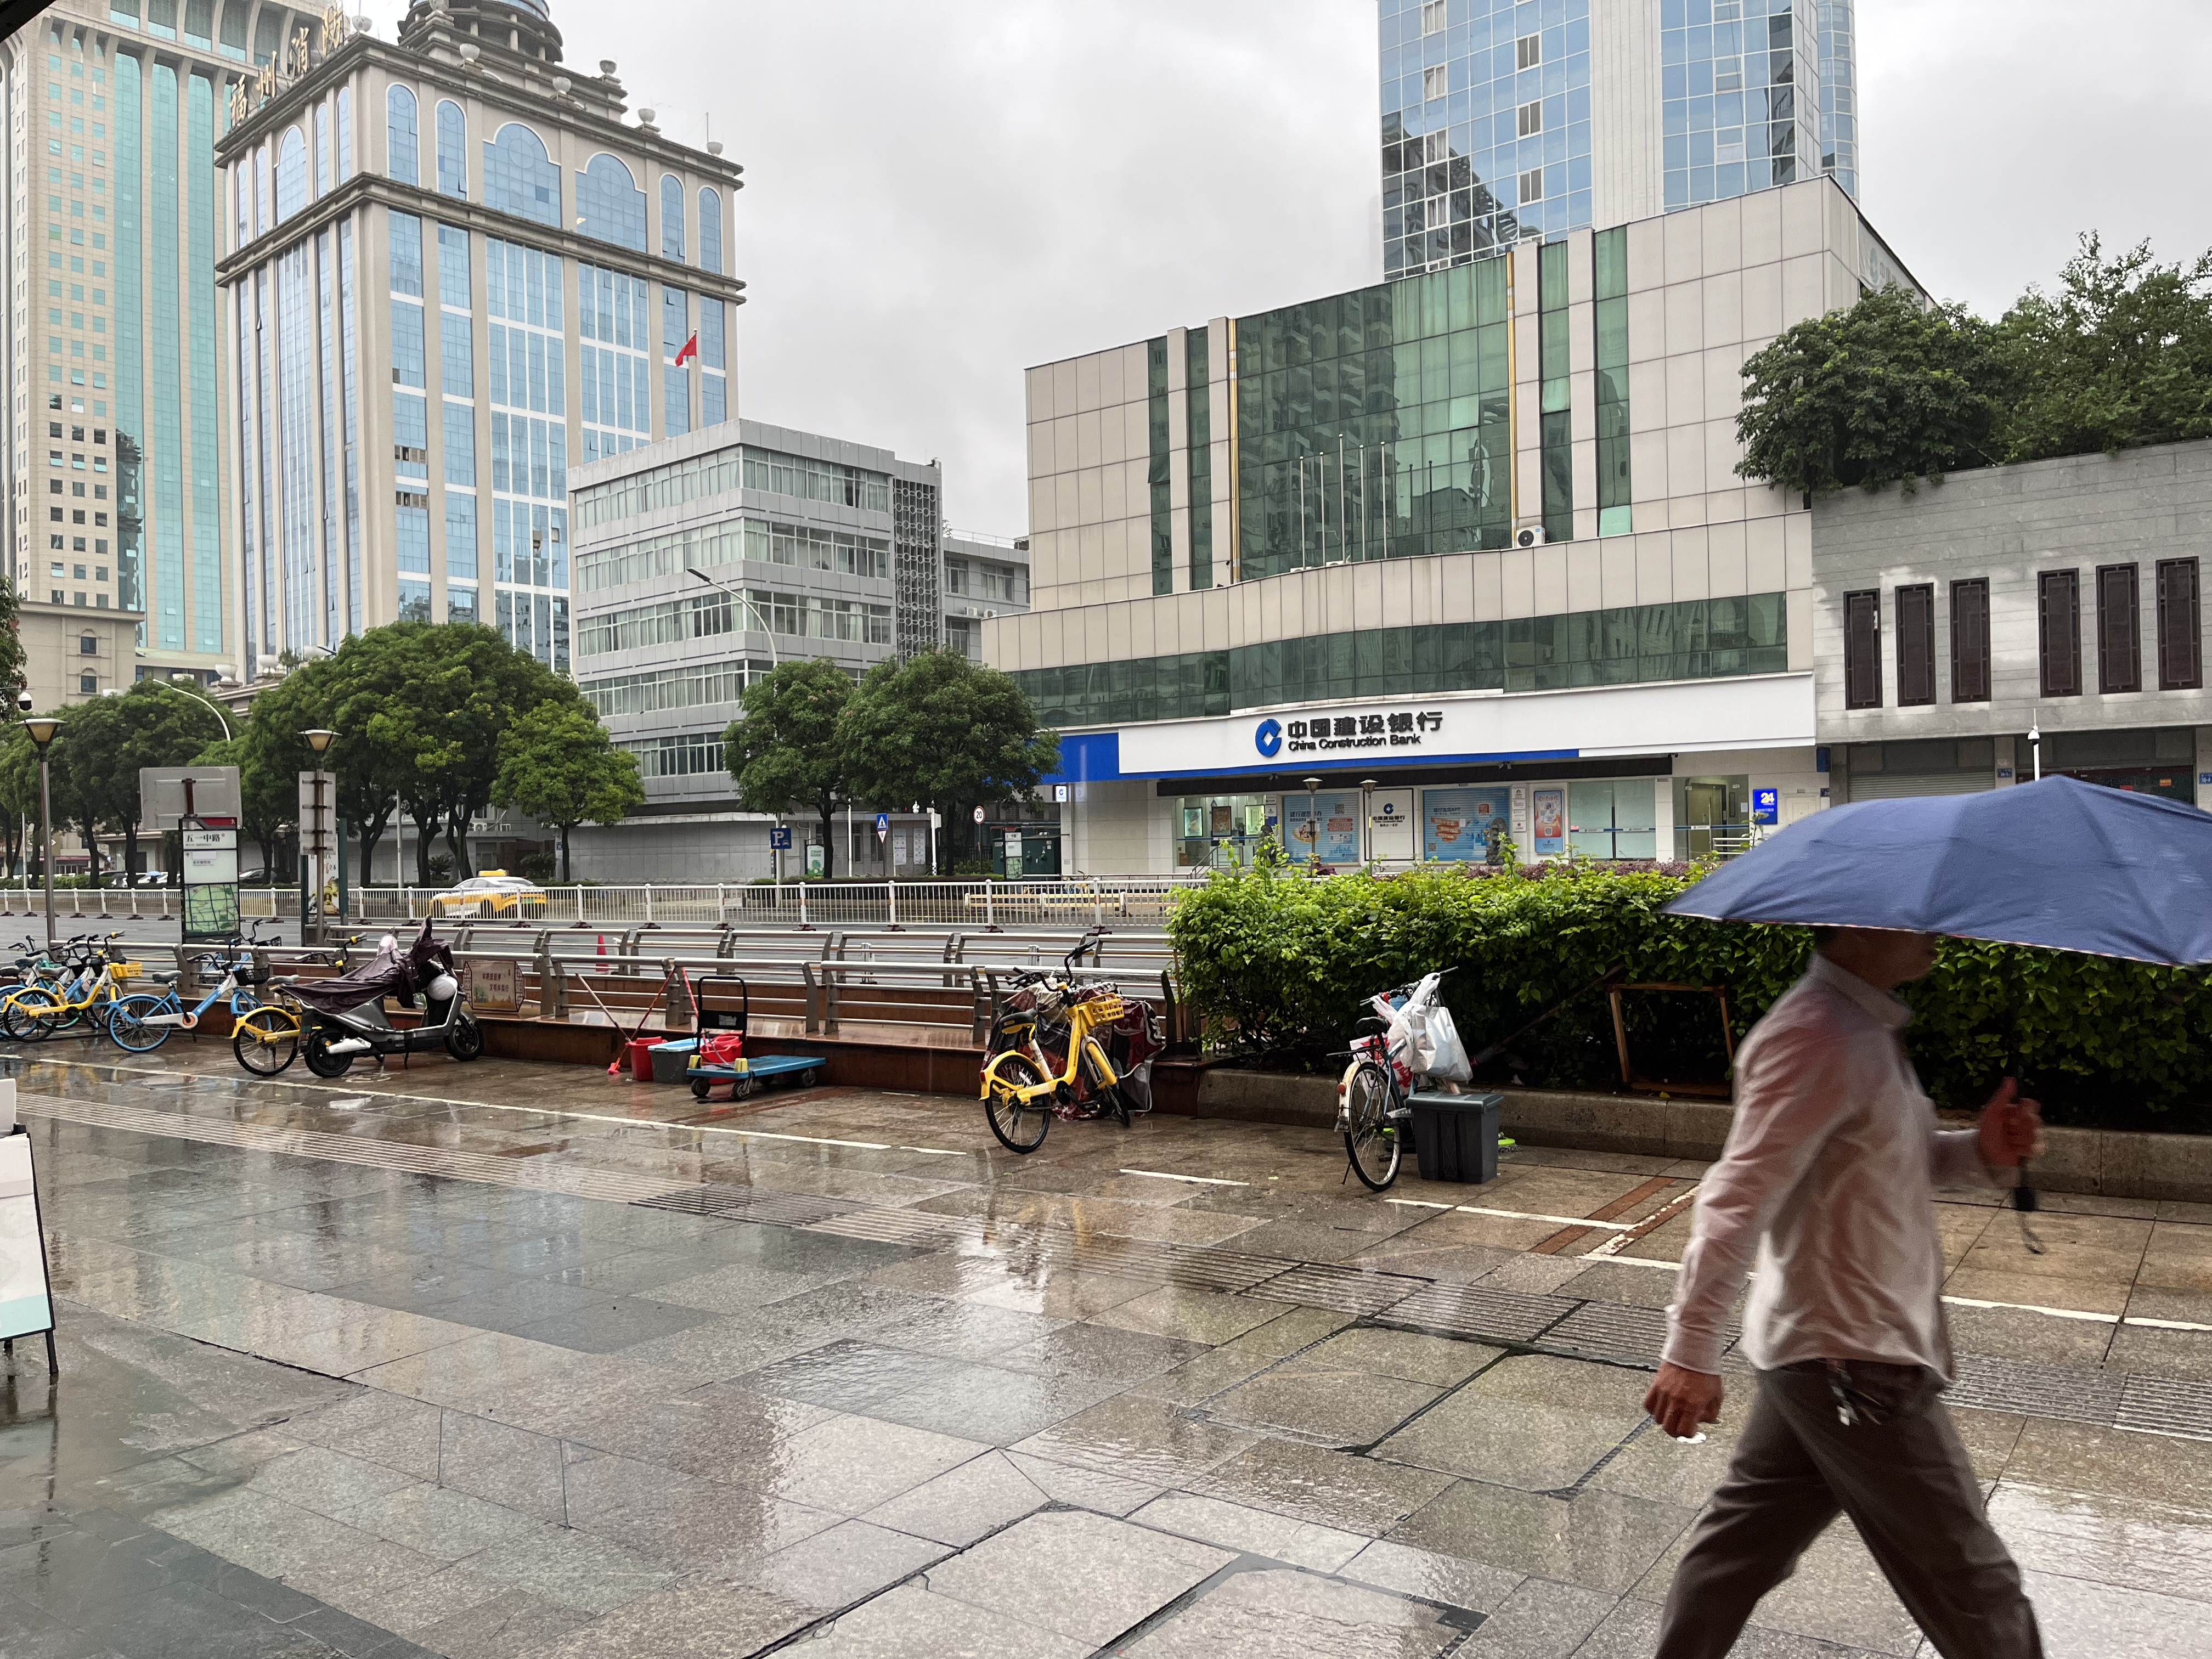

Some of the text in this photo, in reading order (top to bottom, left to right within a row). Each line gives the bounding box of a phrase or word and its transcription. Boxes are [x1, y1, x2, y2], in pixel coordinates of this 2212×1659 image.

[1288, 711, 1443, 738] 中国建设银行
[1288, 733, 1421, 752] China Construction Bank
[1760, 792, 1775, 803] 24
[976, 811, 983, 819] 20
[187, 833, 221, 842] 五一中路
[772, 831, 785, 846] P
